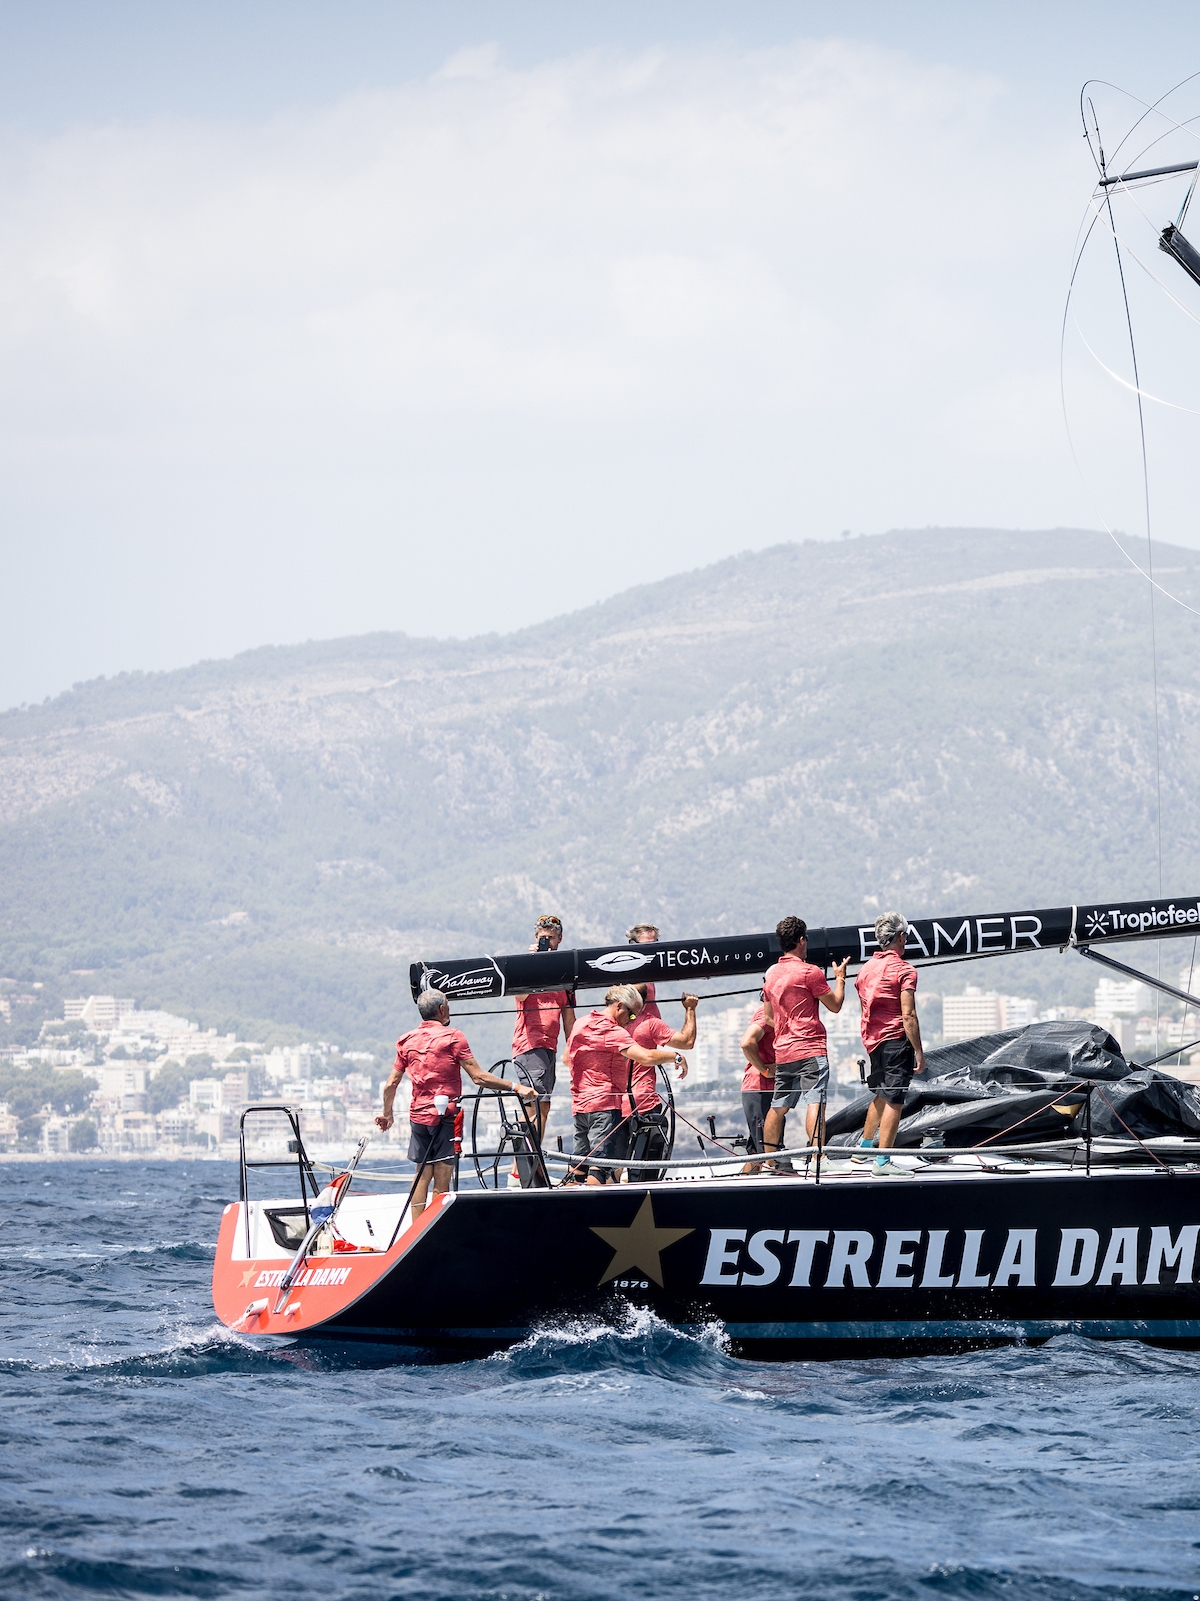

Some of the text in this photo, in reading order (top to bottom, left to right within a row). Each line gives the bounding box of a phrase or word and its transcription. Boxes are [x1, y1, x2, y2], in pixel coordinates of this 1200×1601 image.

[656, 947, 764, 968] TECSA grupo
[699, 1228, 1038, 1288] ESTRELLA
[253, 1267, 353, 1288] ESTRLLA DAMM
[613, 1280, 649, 1288] 1876
